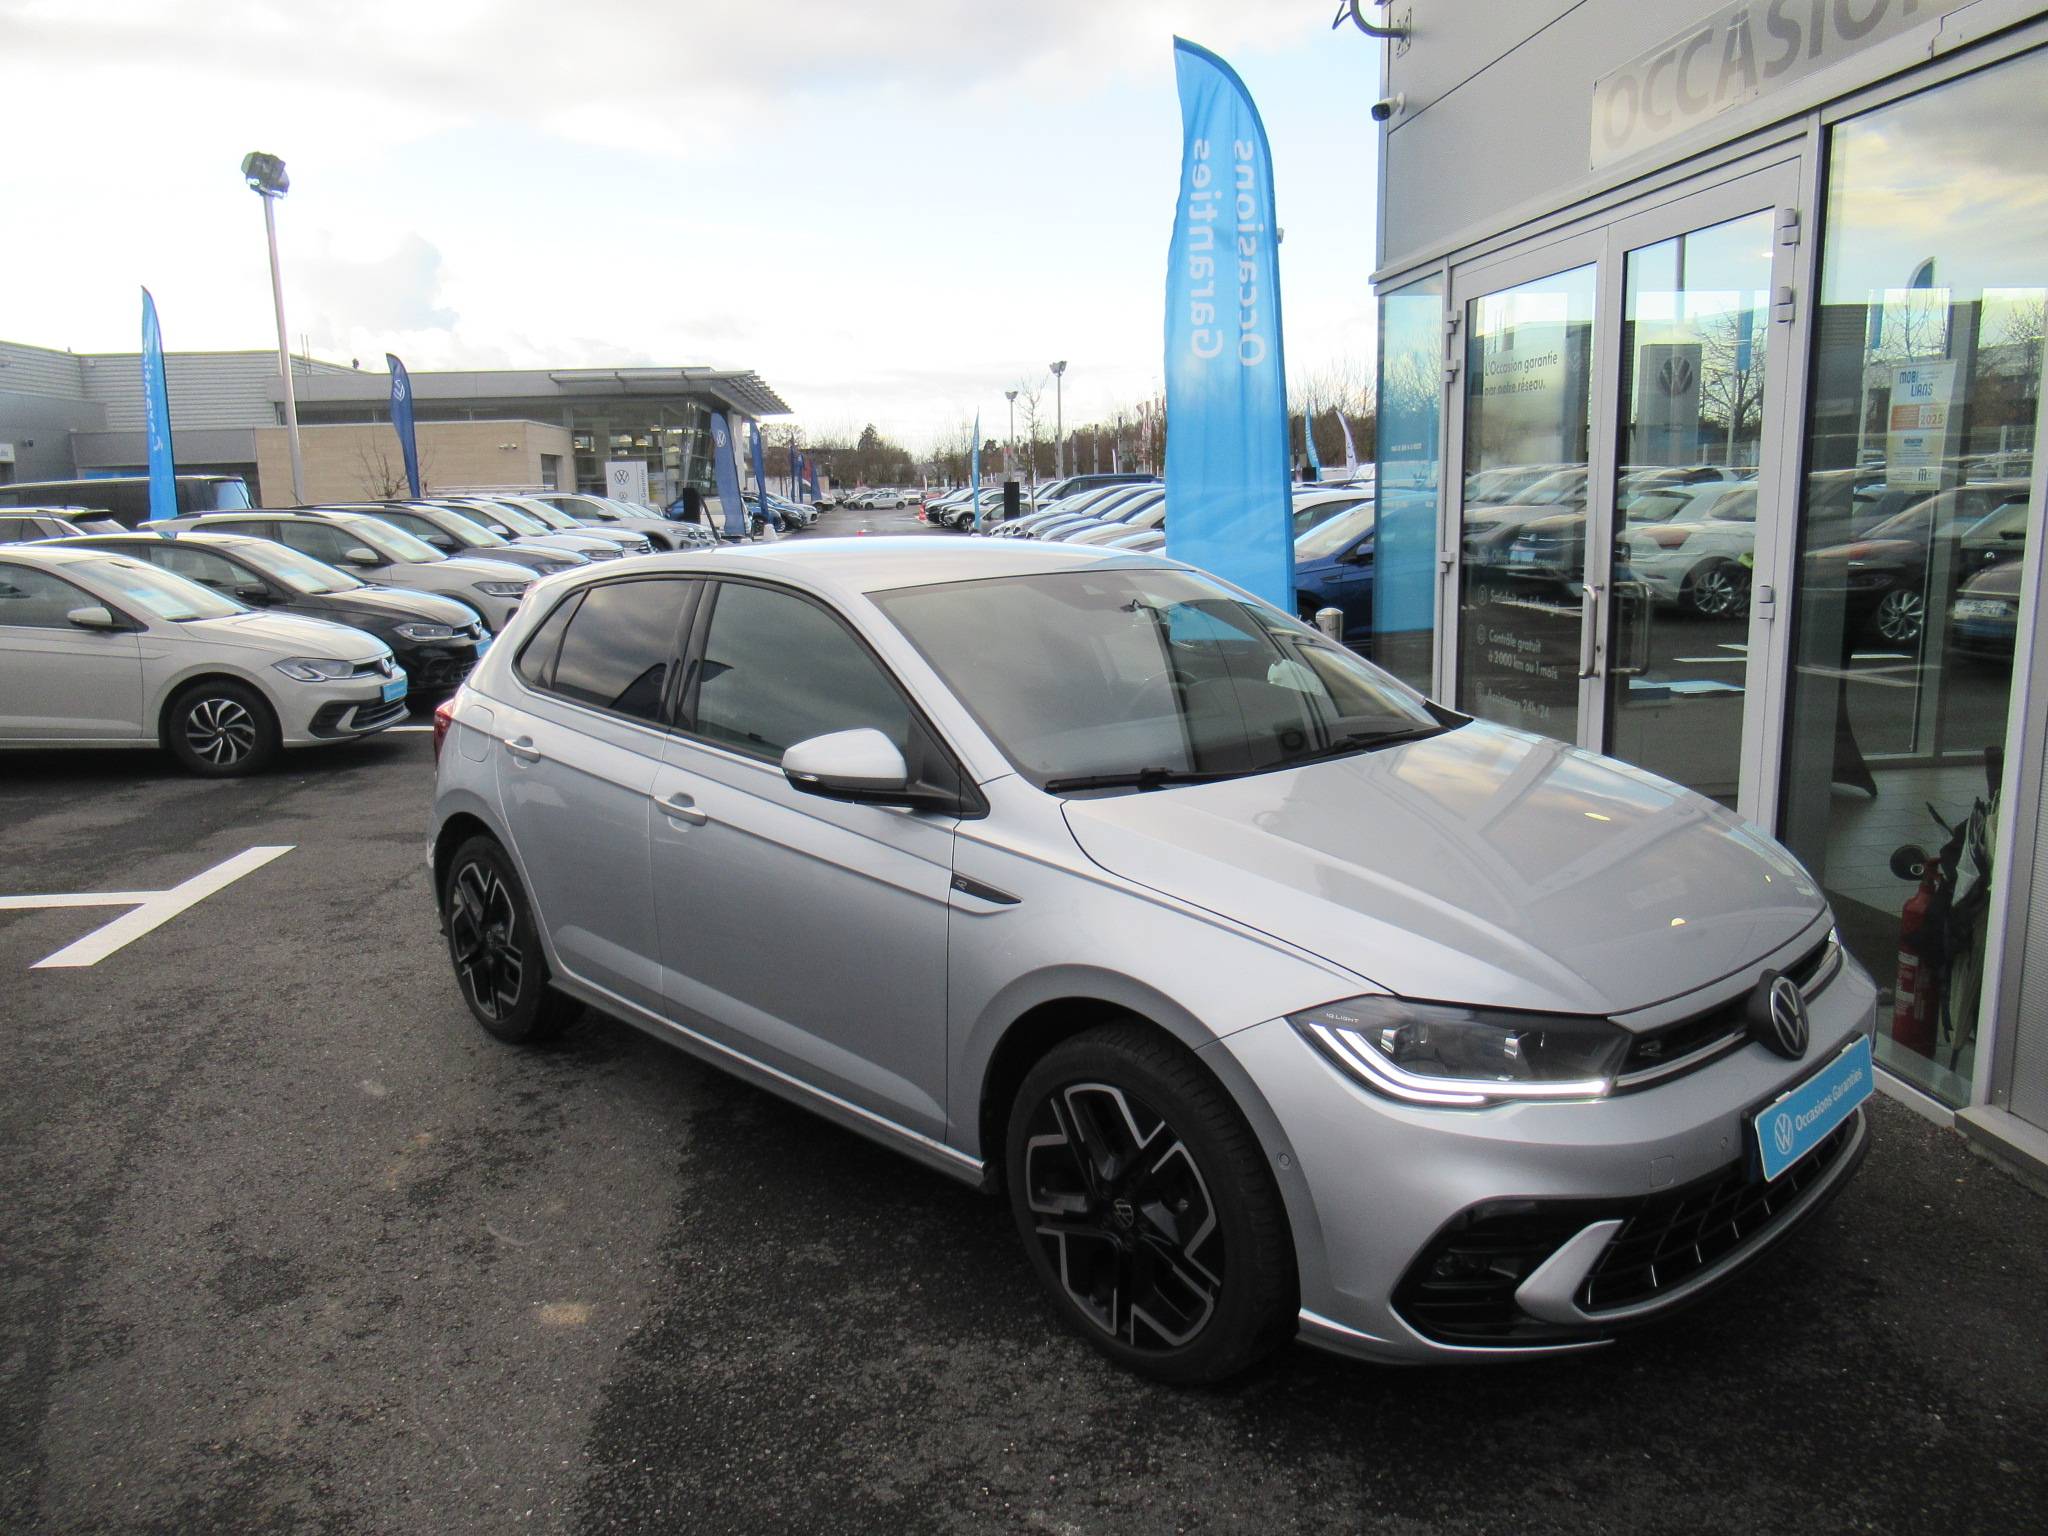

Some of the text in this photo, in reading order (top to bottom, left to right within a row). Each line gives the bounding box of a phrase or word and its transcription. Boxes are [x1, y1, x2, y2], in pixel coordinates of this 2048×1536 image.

[1603, 0, 1919, 150] OCCASI
[1484, 350, 1558, 376] L'Occasion garantie
[1795, 1096, 1834, 1131] Occasions
[1832, 1069, 1863, 1101] Garanties
